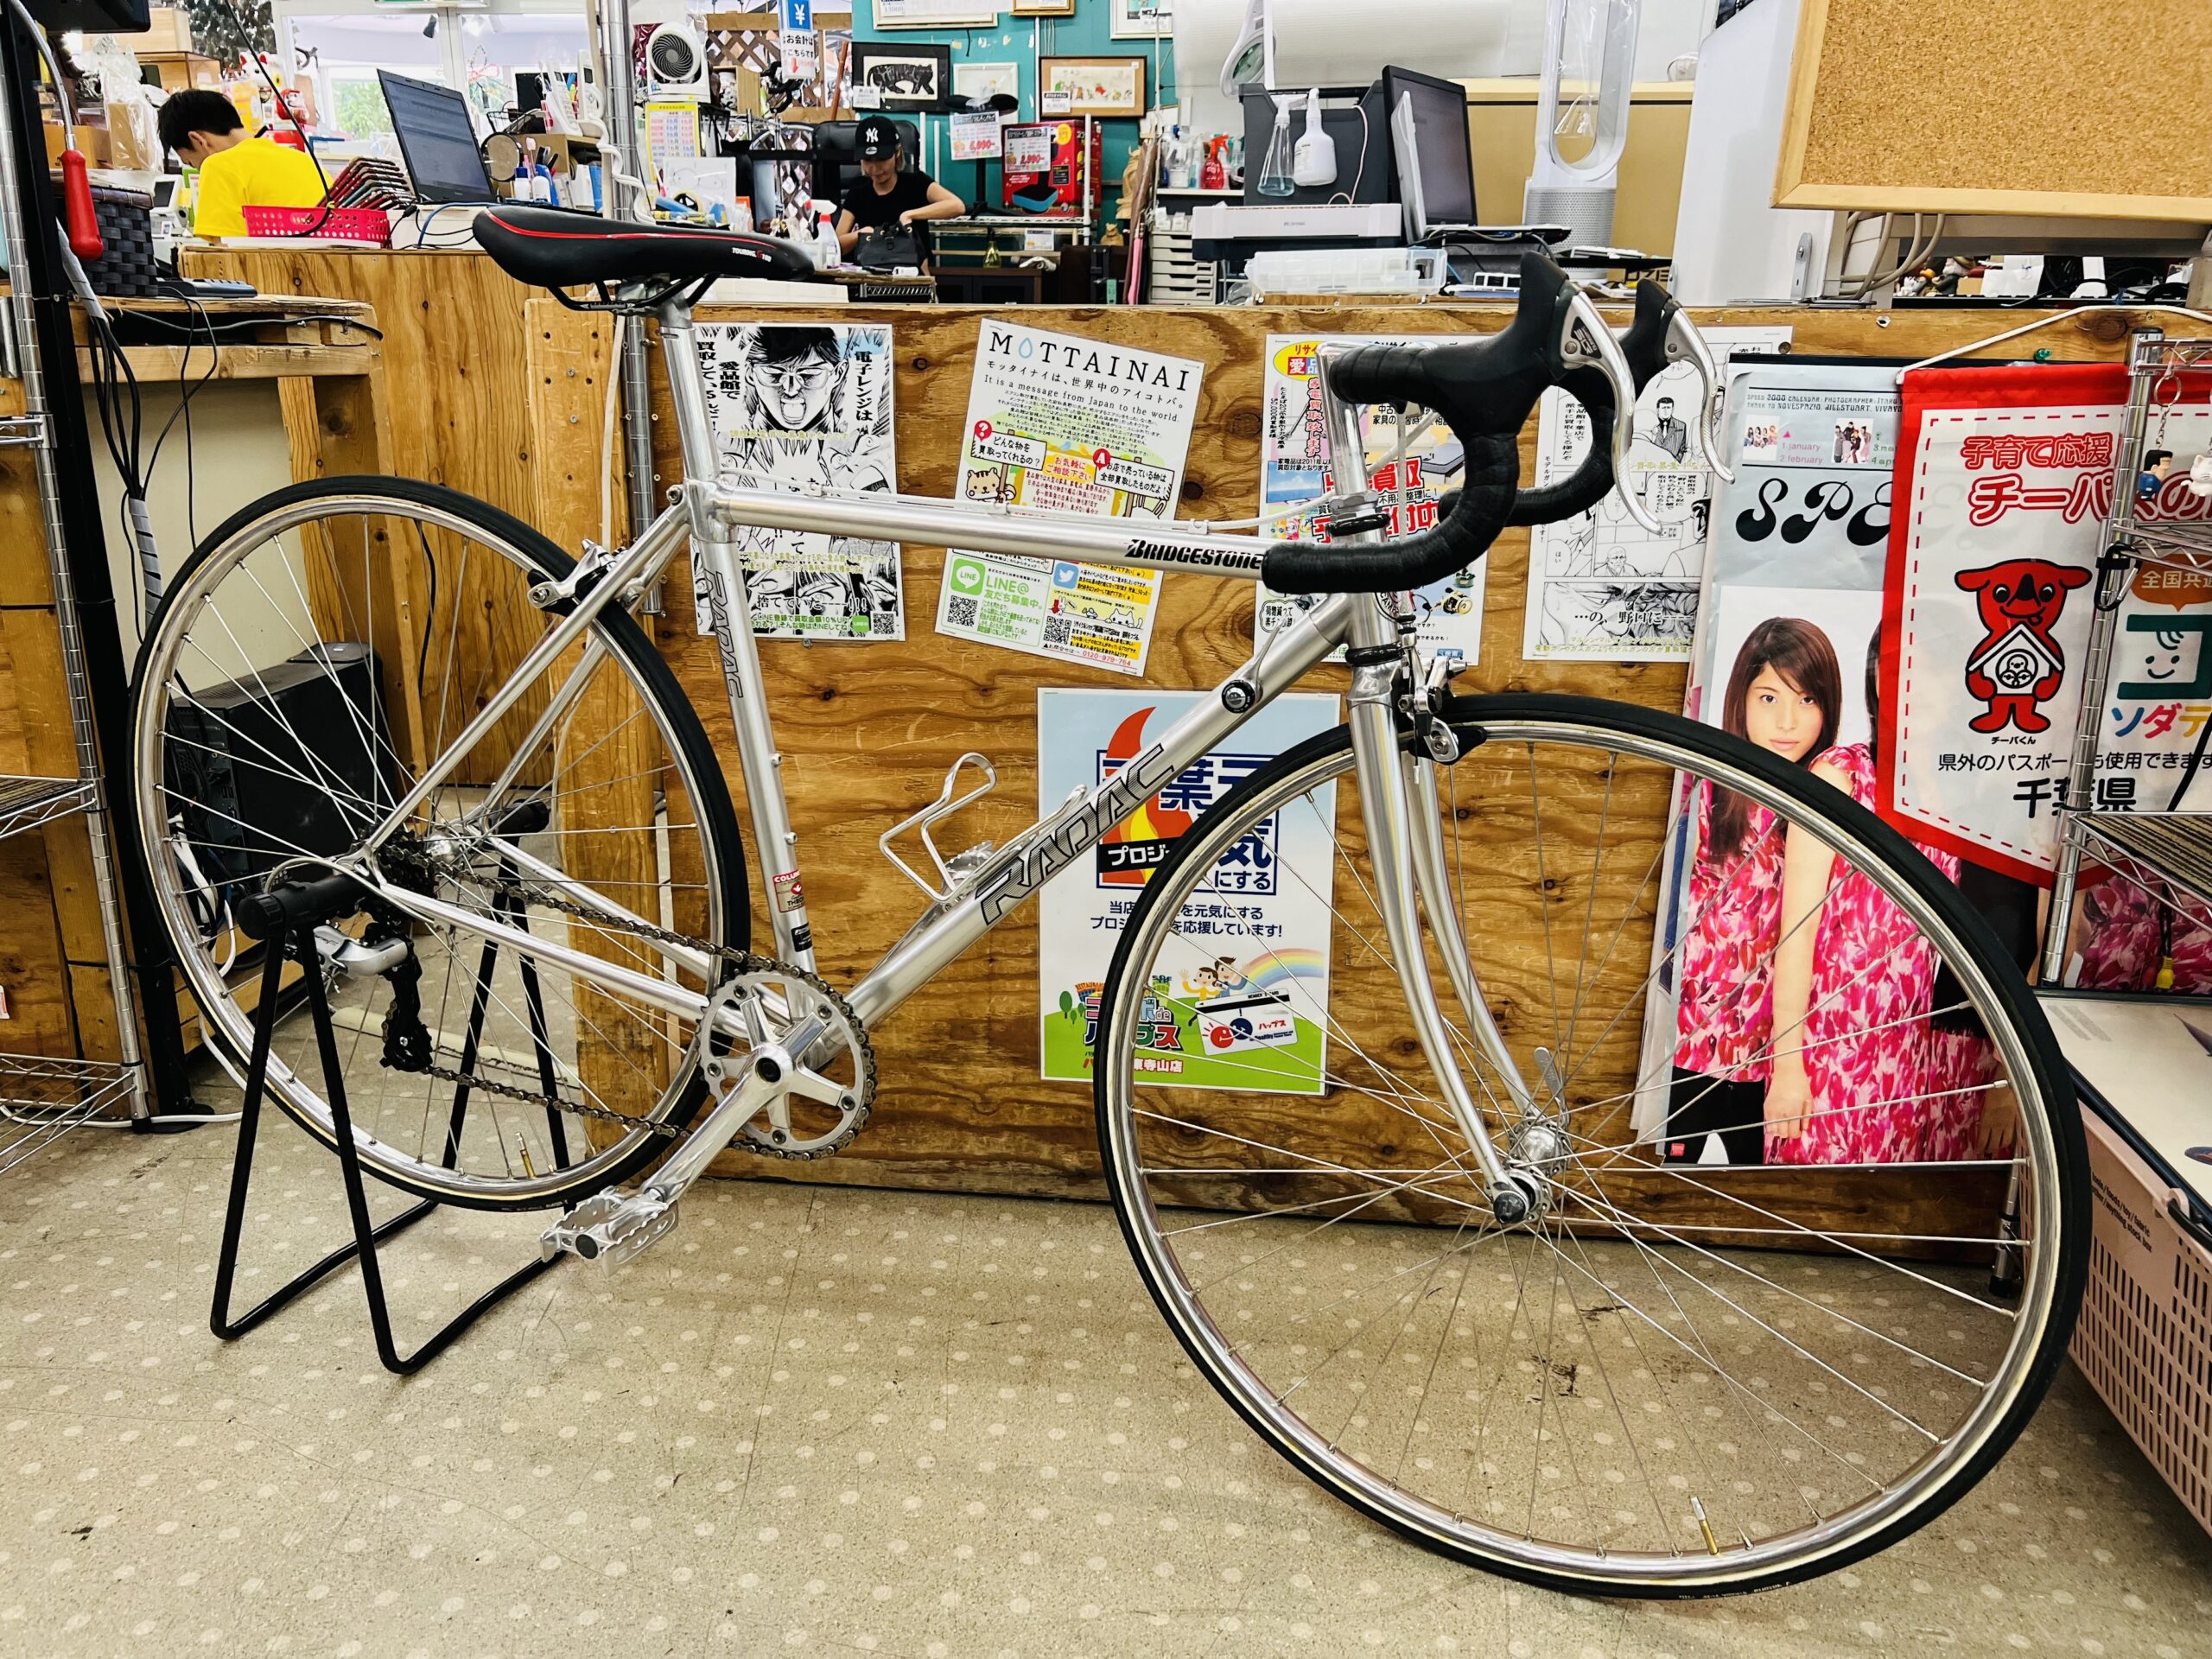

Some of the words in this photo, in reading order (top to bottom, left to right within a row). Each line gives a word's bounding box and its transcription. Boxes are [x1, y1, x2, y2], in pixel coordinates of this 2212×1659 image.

[718, 360, 740, 400] 愛品館で
[855, 350, 873, 422] 電子レンジは
[985, 374, 993, 384] It
[996, 377, 1004, 386] is
[1018, 380, 1058, 398] message
[1063, 391, 1084, 404] from
[1089, 397, 1116, 411] Japan
[1119, 403, 1128, 411] to
[1132, 405, 1147, 416] the
[1151, 410, 1180, 423] world.
[993, 435, 1030, 453] どんな物を
[1961, 432, 2113, 469] 子育て応援
[978, 443, 1040, 467] 買取ってくれるの?
[1055, 456, 1086, 470] お気軽に
[1046, 464, 1091, 480] ご相談下さい
[1107, 461, 1166, 483] お店で売っている物は
[1100, 472, 1166, 495] 全部買取したものだよ!
[960, 571, 977, 581] LINE
[987, 575, 1029, 594] LINE@
[984, 589, 1042, 610] 友だち募集中。
[1213, 869, 1271, 890] にする
